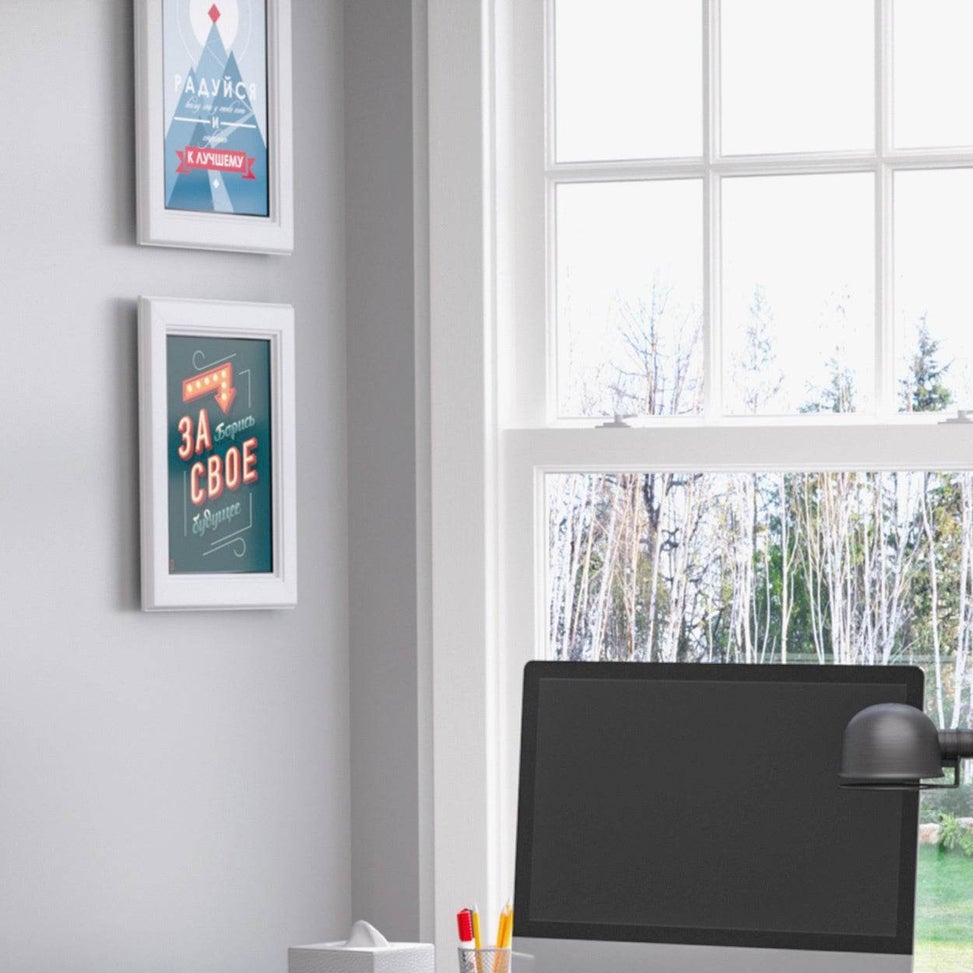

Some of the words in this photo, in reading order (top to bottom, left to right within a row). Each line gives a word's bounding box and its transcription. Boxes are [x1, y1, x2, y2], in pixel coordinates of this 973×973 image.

[174, 74, 257, 101] РАДУЙСЯ
[187, 151, 194, 164] К
[196, 153, 244, 168] ЛУЧШЕМУ
[178, 408, 211, 460] ЗА
[190, 437, 258, 504] СВОЕ
